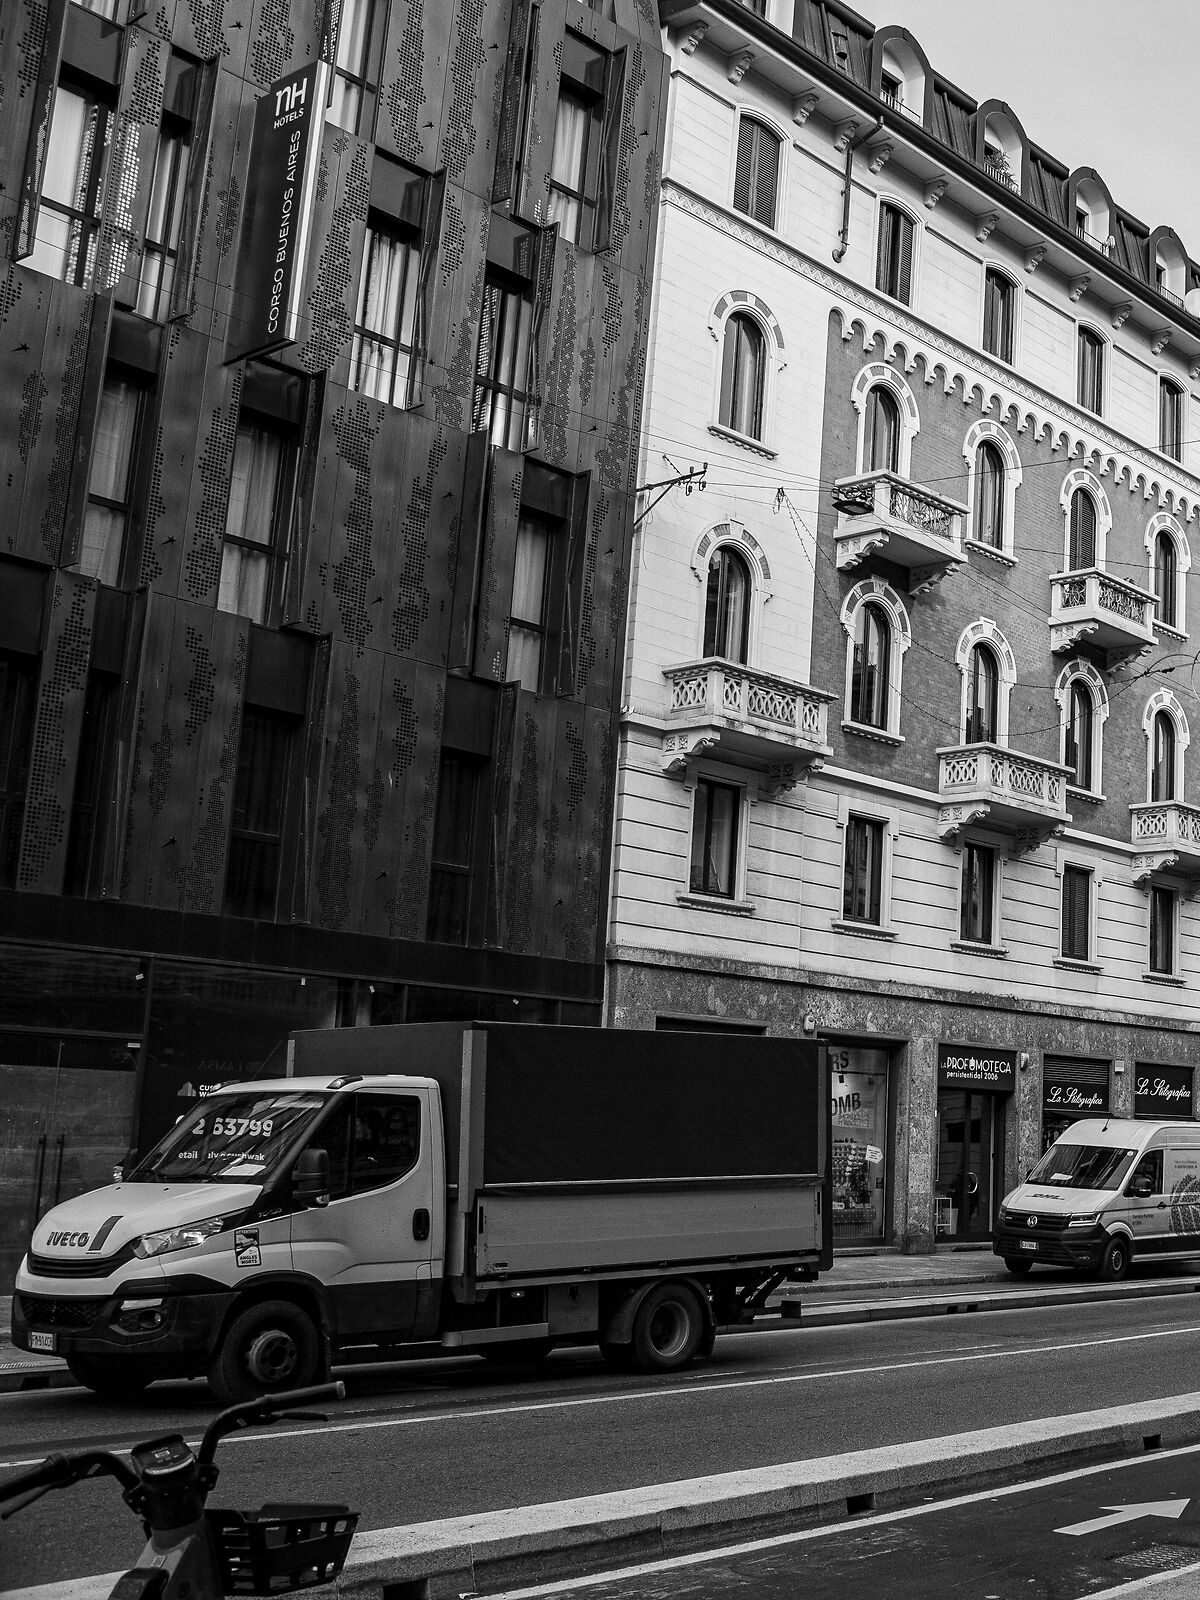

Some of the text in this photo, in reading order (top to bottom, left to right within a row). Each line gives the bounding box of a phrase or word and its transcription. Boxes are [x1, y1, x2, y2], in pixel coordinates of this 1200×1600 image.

[273, 107, 304, 129] HOTELS
[267, 130, 301, 334] CORSO BUENOS AIRES
[1046, 1086, 1103, 1108] La Stilografica
[1134, 1077, 1191, 1100] La Stilografica
[46, 1231, 91, 1247] IVECO
